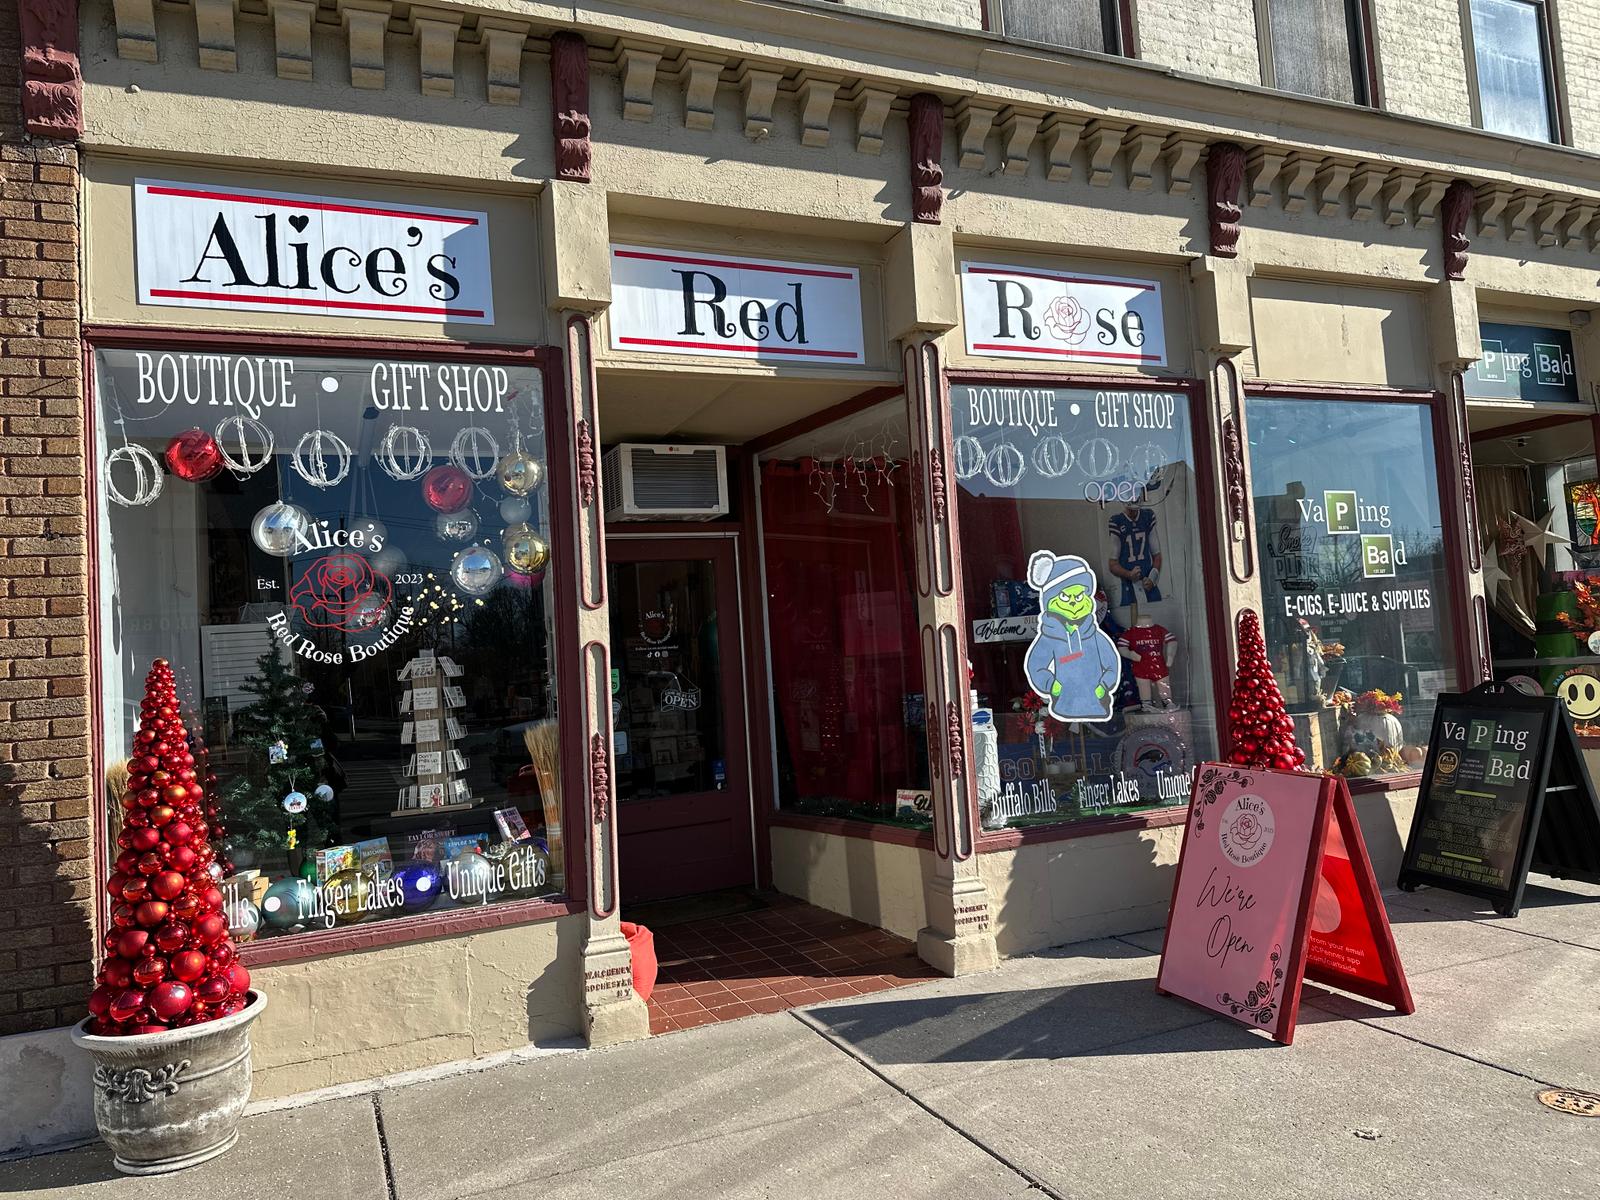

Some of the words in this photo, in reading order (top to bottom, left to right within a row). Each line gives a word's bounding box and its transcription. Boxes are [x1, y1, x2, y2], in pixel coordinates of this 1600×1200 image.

[180, 211, 461, 301] Alice's
[672, 270, 809, 344] Red
[136, 352, 296, 419] BOUTIQUE
[371, 362, 431, 411] GIFT
[437, 365, 509, 413] SHOP
[969, 388, 1059, 436] BOUTIQUE
[1095, 392, 1131, 429] GIFT
[1134, 394, 1175, 430] SHOP
[1084, 481, 1147, 509] open
[293, 520, 384, 555] Alice's
[1125, 532, 1146, 562] 17
[1367, 541, 1407, 567] Bad
[257, 579, 280, 590] Est.
[395, 573, 424, 584] 2023
[1284, 594, 1326, 617] E-CIGS,
[1328, 592, 1368, 614] E-JUICE
[1372, 595, 1380, 611] &
[1382, 589, 1430, 610] SUPPLIES
[266, 610, 297, 647] Red
[296, 638, 343, 665] Rose
[350, 604, 414, 663] Boutique
[975, 619, 1026, 640] Welcome
[664, 694, 697, 708] OPEN
[1156, 766, 1193, 805] Unique
[1488, 757, 1531, 781] Bad
[991, 779, 1032, 819] Buffalo
[1032, 778, 1057, 814] Bills
[1077, 777, 1111, 815] Finger
[1110, 771, 1140, 804] Lakes
[1236, 797, 1266, 816] Alice's
[1221, 833, 1230, 848] Red
[1226, 847, 1241, 862] Rose
[1241, 842, 1267, 863] Boutique
[447, 853, 505, 905] Unique
[507, 844, 547, 890] Gifts
[1197, 866, 1257, 912] We're
[297, 875, 352, 928] Finger
[356, 863, 404, 912] Lakes
[1206, 914, 1254, 968] Open
